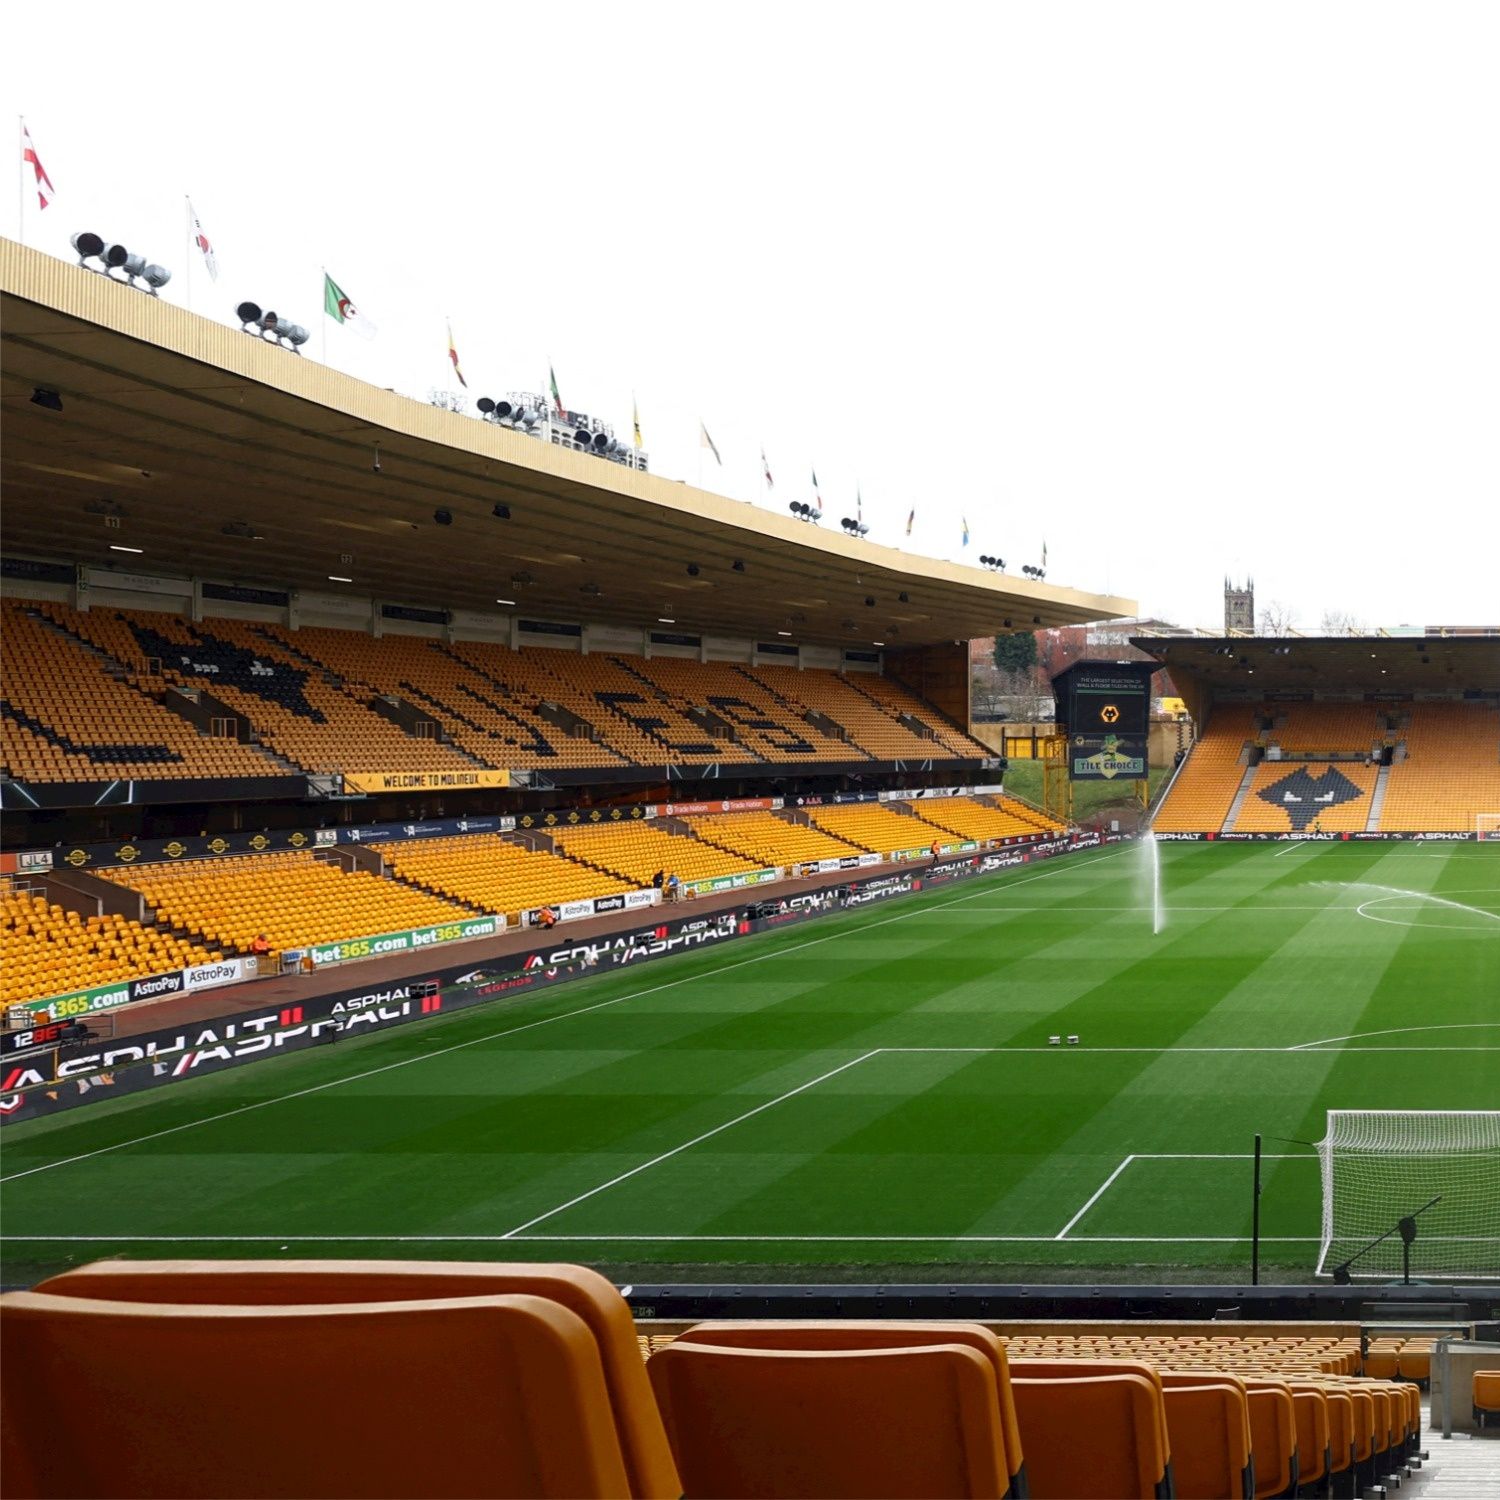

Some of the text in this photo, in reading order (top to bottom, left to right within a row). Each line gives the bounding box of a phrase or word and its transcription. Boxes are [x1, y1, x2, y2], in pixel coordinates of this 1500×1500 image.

[1104, 761, 1138, 769] CHOICE
[383, 773, 479, 788] WELCOME TO MOLINEUX
[673, 804, 708, 813] Trade Nation
[746, 801, 763, 809] Nation
[1417, 832, 1470, 840] ASPHALT
[26, 853, 48, 866] JL4
[733, 873, 775, 888] bet365.com
[597, 897, 622, 909] AstroPay
[564, 904, 590, 916] AstroPay
[311, 921, 493, 964] bet365.com bet365.com
[246, 959, 256, 967] 10
[189, 964, 236, 984] AstroPay
[134, 976, 181, 997] AstroPay
[13, 1022, 70, 1048] 12BET
